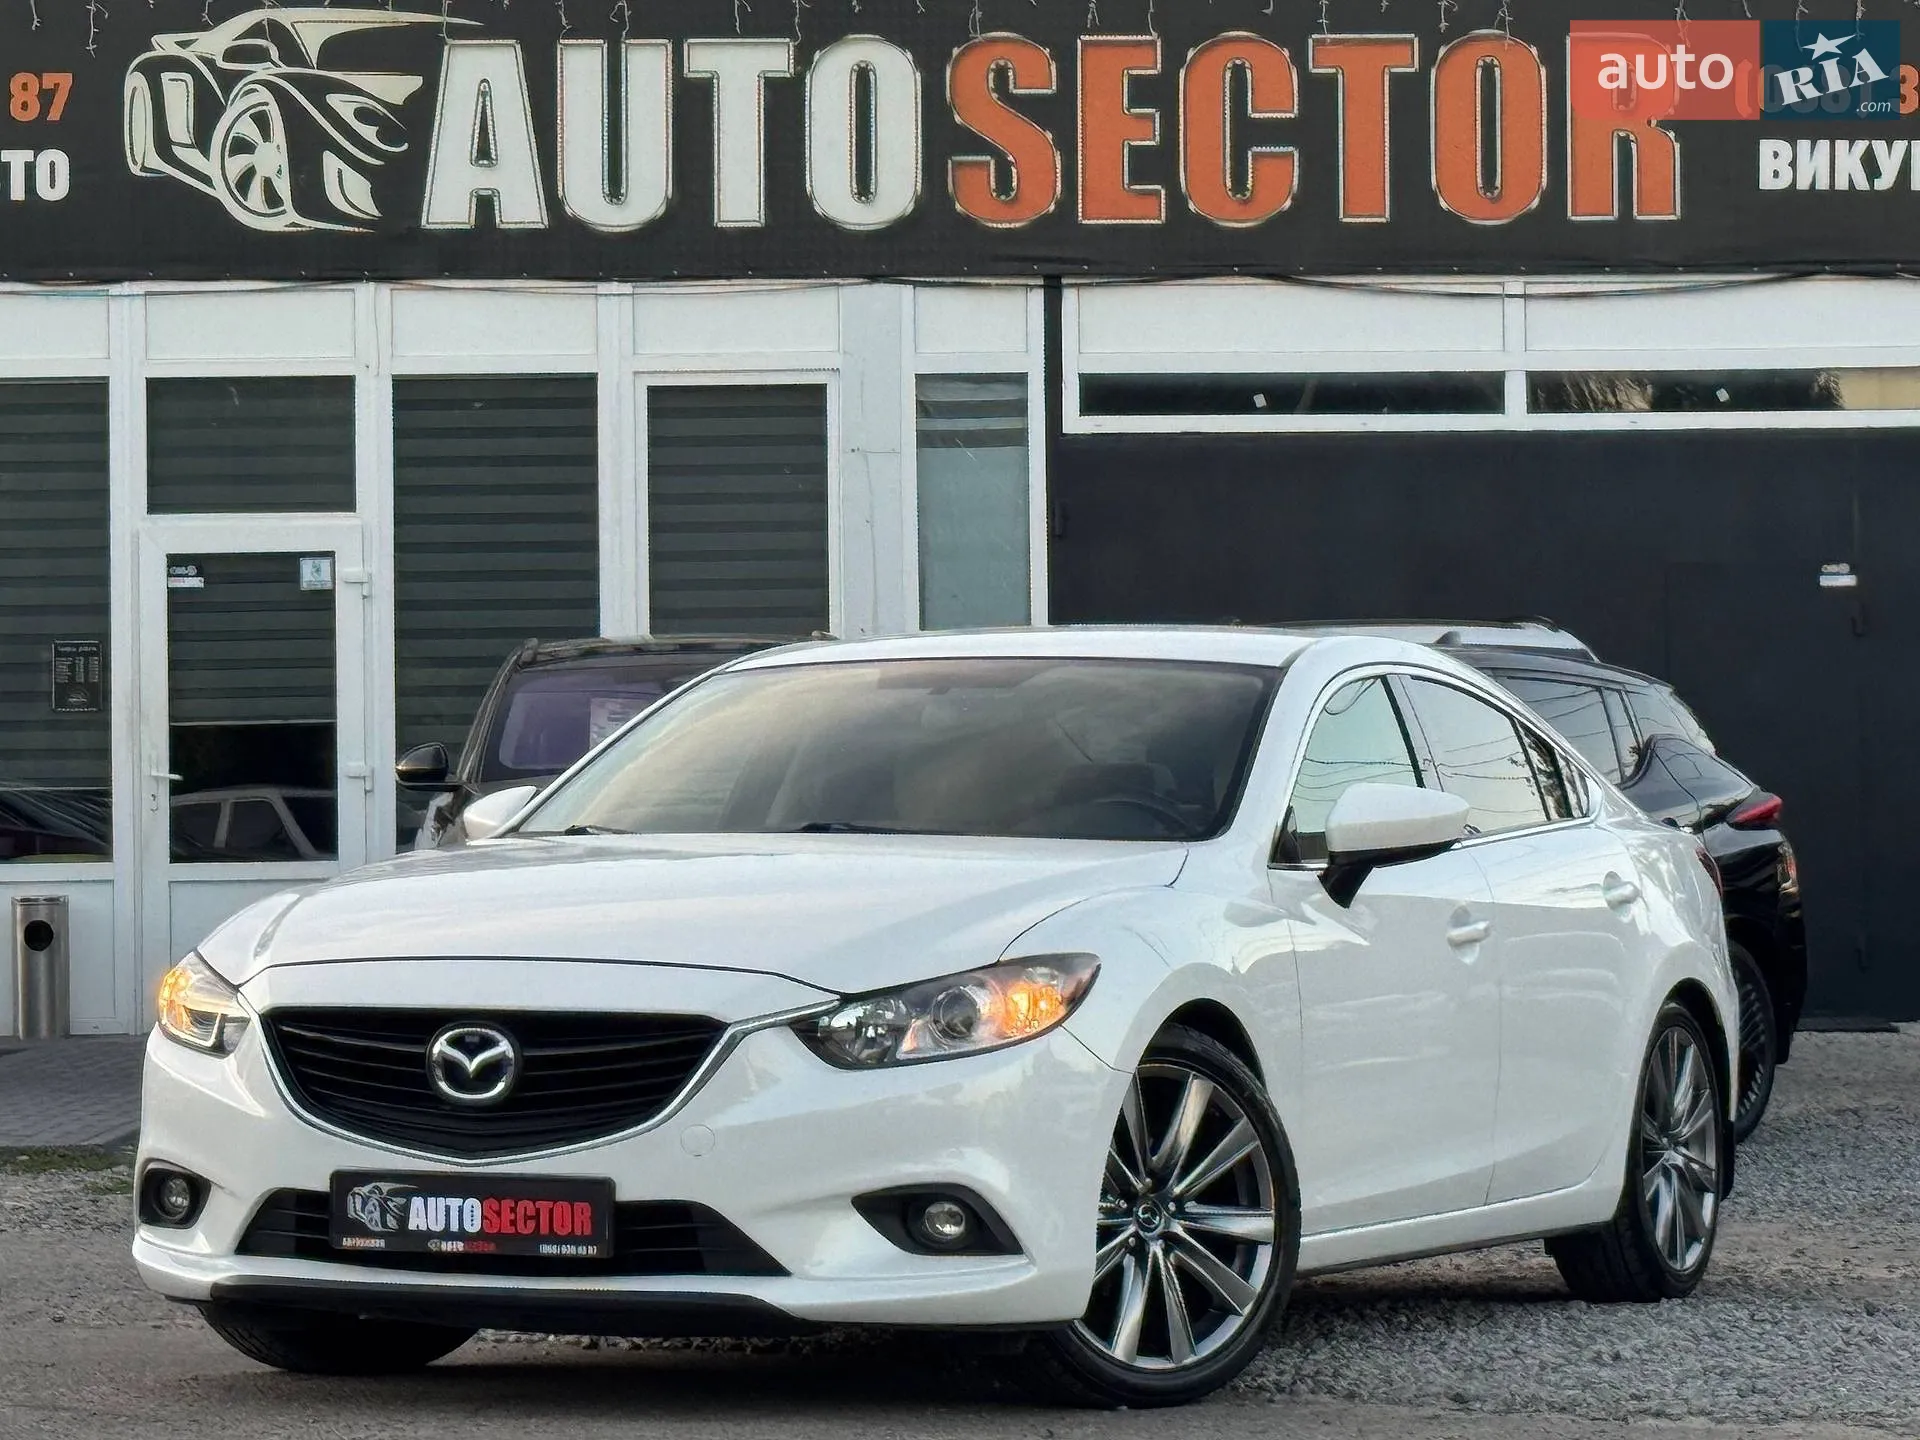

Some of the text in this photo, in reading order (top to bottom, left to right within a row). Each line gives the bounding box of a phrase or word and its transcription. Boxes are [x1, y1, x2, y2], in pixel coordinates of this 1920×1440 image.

[9, 71, 73, 122] 87
[420, 31, 1682, 232] AUTOSECTOR
[407, 1195, 593, 1237] AUTOSECTOR
